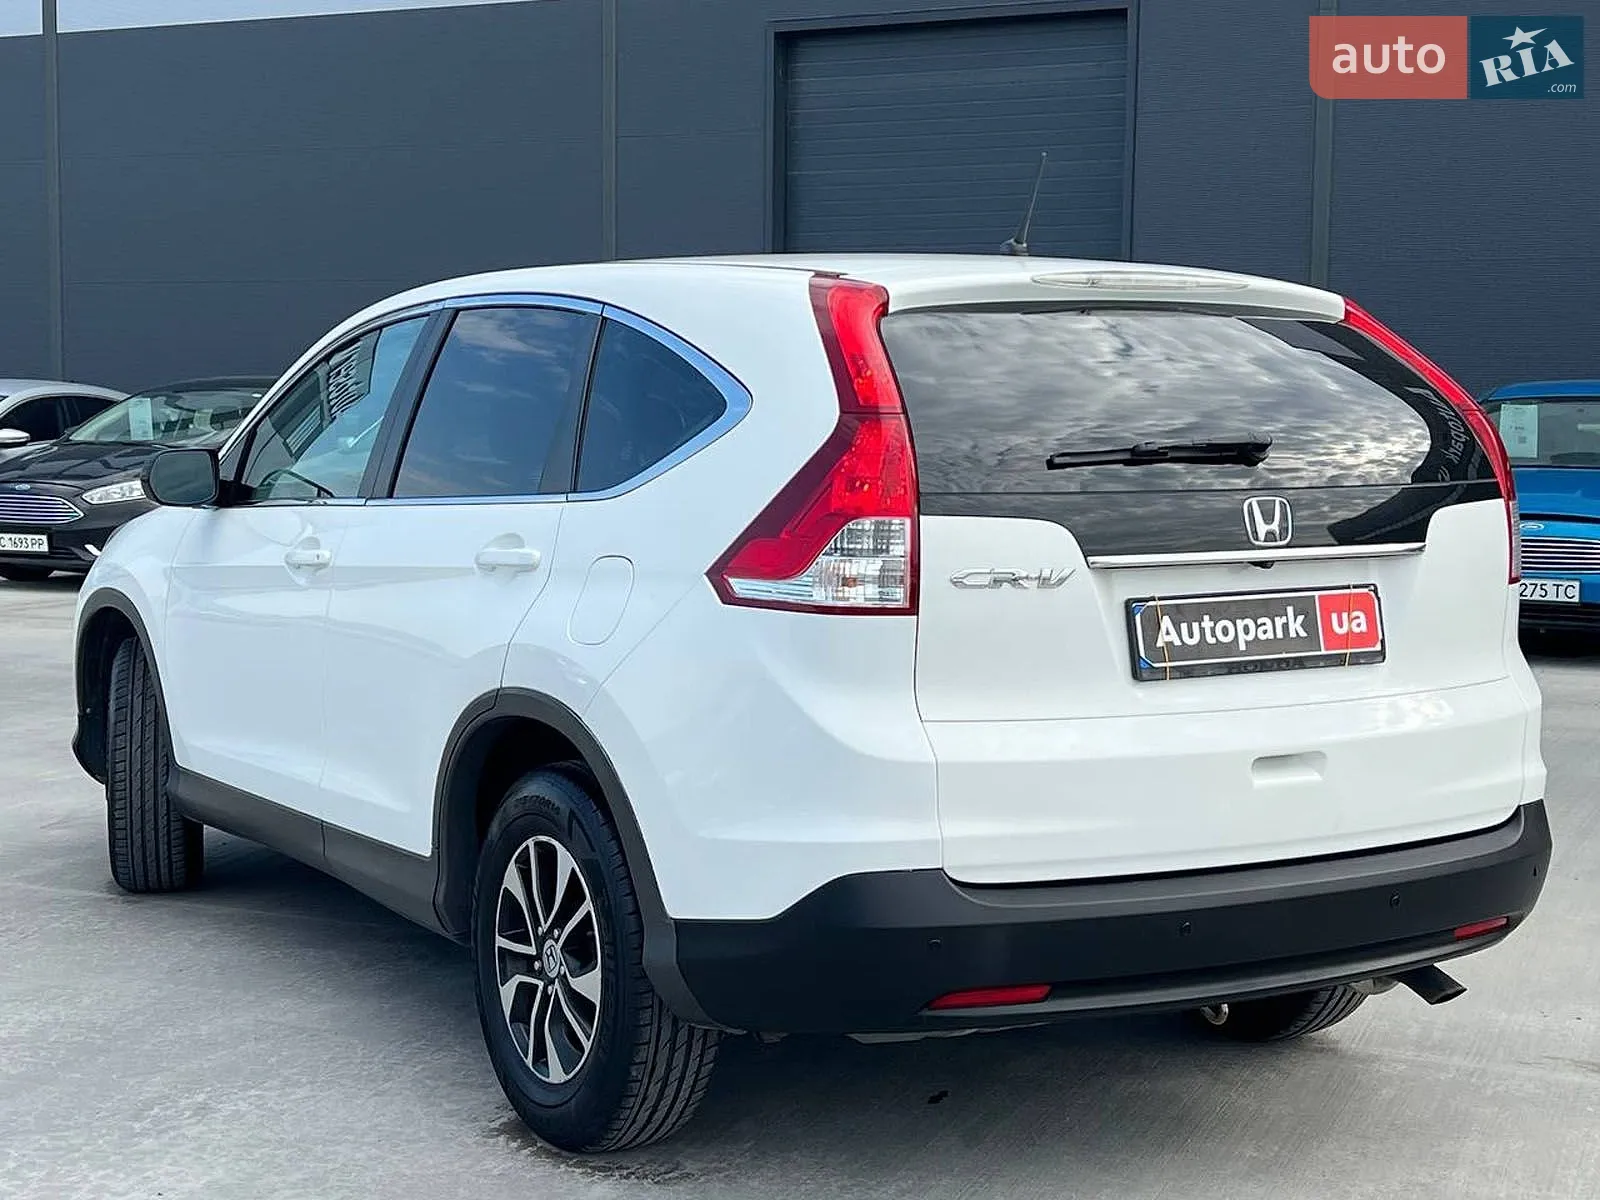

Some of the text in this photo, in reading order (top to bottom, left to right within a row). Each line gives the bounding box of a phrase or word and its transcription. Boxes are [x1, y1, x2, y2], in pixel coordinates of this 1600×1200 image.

[951, 567, 1077, 589] CR-V
[1552, 583, 1576, 599] TC
[1156, 606, 1367, 651] Autopark ua
